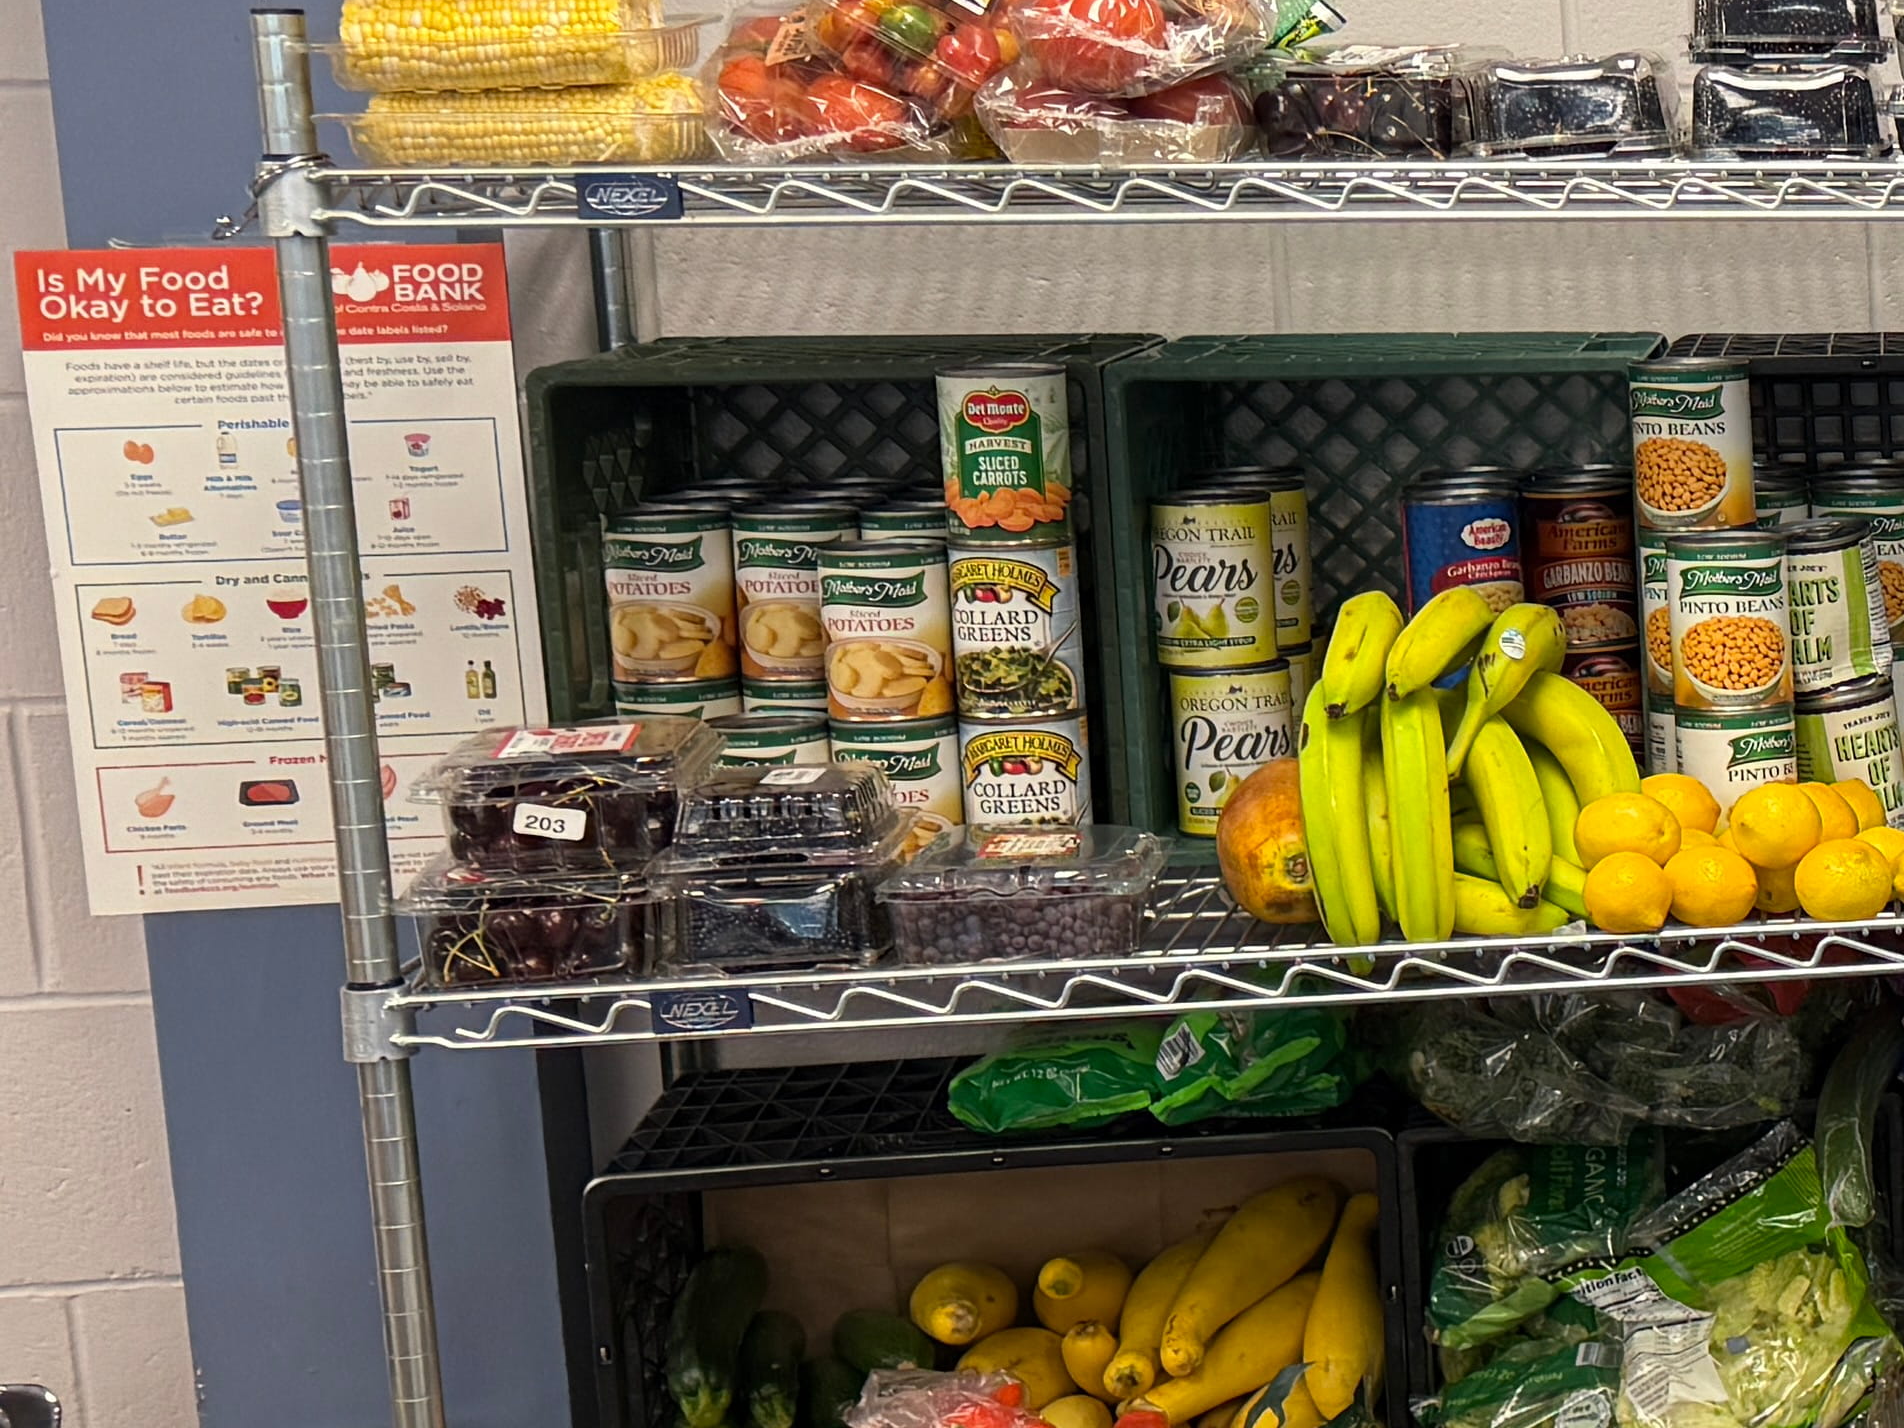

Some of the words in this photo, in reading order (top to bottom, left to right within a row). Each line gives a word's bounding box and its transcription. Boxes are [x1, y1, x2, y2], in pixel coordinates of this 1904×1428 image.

[597, 187, 657, 203] NEXEL
[37, 268, 64, 292] Is
[77, 268, 126, 297] My
[140, 265, 229, 291] Food
[392, 264, 484, 283] FOOD
[393, 282, 486, 302] BANK
[40, 295, 130, 322] Okay
[140, 294, 177, 317] to
[190, 292, 263, 317] Eat?
[349, 304, 389, 314] Contra
[391, 304, 429, 313] Costa
[431, 304, 440, 312] &
[442, 303, 487, 312] Solano
[43, 332, 63, 342] Did
[65, 333, 88, 343] you
[90, 332, 122, 341] know
[124, 331, 148, 340] that
[150, 331, 179, 339] most
[182, 329, 216, 339] foods
[218, 330, 236, 338] are
[239, 328, 262, 337] safe
[265, 329, 277, 337] to
[349, 326, 374, 336] date
[377, 325, 410, 335] labels
[412, 324, 448, 335] listed?
[65, 362, 100, 371] Foods
[103, 361, 131, 371] have
[143, 360, 170, 370] shelf
[195, 359, 215, 369] but
[239, 358, 269, 368] dates
[159, 371, 222, 381] considered
[225, 370, 281, 381] guidelines
[158, 383, 192, 393] below
[210, 382, 264, 392] estimate
[216, 394, 248, 404] foods
[986, 403, 1025, 415] Monte
[217, 419, 290, 430] Perishable
[1668, 422, 1726, 436] BEANS
[970, 439, 1026, 450] HARVEST
[978, 456, 1019, 471] SLICED
[973, 471, 1027, 485] CARROTS
[1205, 527, 1256, 541] TRAIL
[1469, 523, 1507, 535] American
[1564, 537, 1617, 551] Farms
[645, 546, 693, 564] Maid
[767, 571, 799, 580] Sliced
[999, 563, 1041, 588] HOLMES
[1154, 544, 1257, 593] Pears
[1447, 560, 1500, 577] Garbanzo
[1543, 563, 1602, 589] GARBANZO
[216, 575, 239, 586] Dry
[244, 575, 269, 584] and
[627, 574, 657, 582] Sliced
[1738, 570, 1777, 591] Maid
[870, 581, 917, 602] Maid
[1680, 600, 1729, 614] PINTO
[1736, 596, 1784, 614] BEANS
[849, 609, 881, 618] Sliced
[953, 609, 1038, 625] COLLARD
[828, 617, 915, 632] POTATOES
[958, 627, 1031, 641] GREENS
[1181, 697, 1248, 711] OREGON
[1843, 716, 1873, 730] TRADER
[969, 737, 1018, 760] MARGARET
[1023, 737, 1069, 759] HOLMES
[1180, 715, 1291, 770] Pears
[269, 755, 316, 766] Frozen
[1729, 765, 1780, 782] PINTO
[1868, 763, 1891, 786] OF
[973, 780, 1066, 798] COLLARD
[980, 797, 1060, 814] GREENS
[525, 815, 565, 833] 203
[671, 1001, 736, 1017] NEXEL
